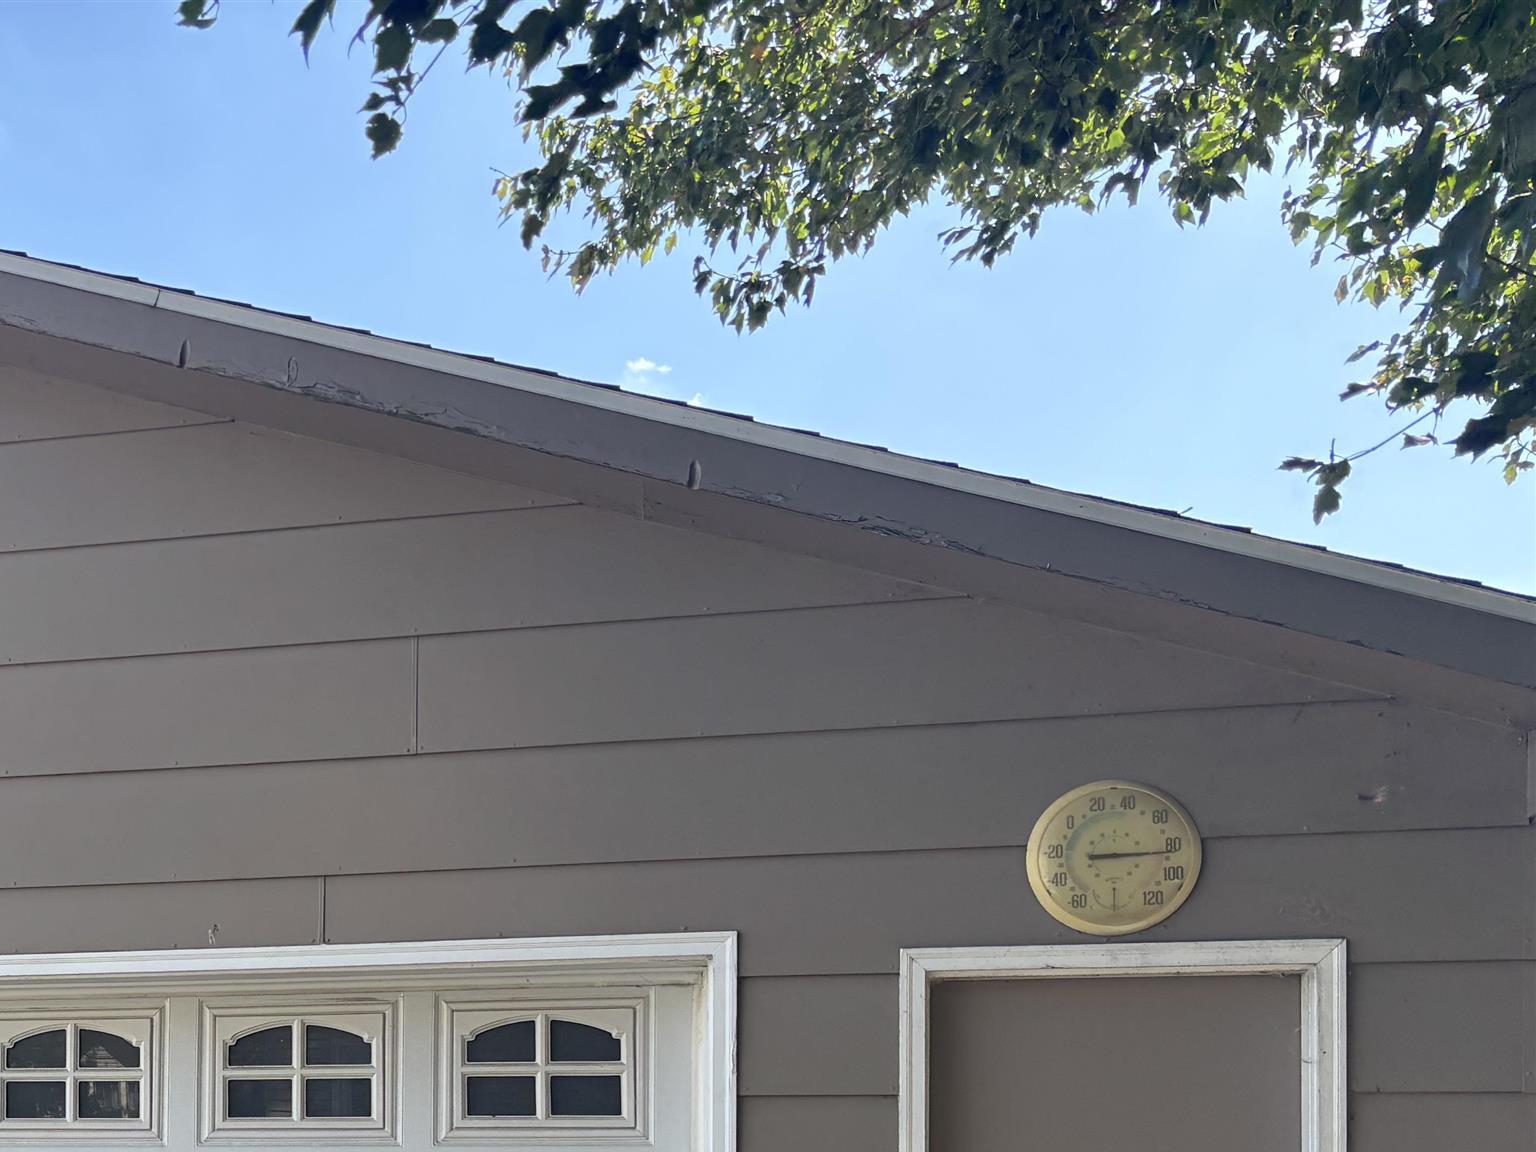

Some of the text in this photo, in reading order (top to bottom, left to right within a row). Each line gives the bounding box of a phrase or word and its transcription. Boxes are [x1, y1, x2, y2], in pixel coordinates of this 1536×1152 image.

[1089, 797, 1105, 812] 20
[1120, 796, 1136, 810] 40
[1066, 815, 1074, 830] 0
[1152, 809, 1168, 824] 60
[1165, 837, 1181, 852] 80
[1163, 866, 1184, 881] 100
[1143, 890, 1163, 906] 120
